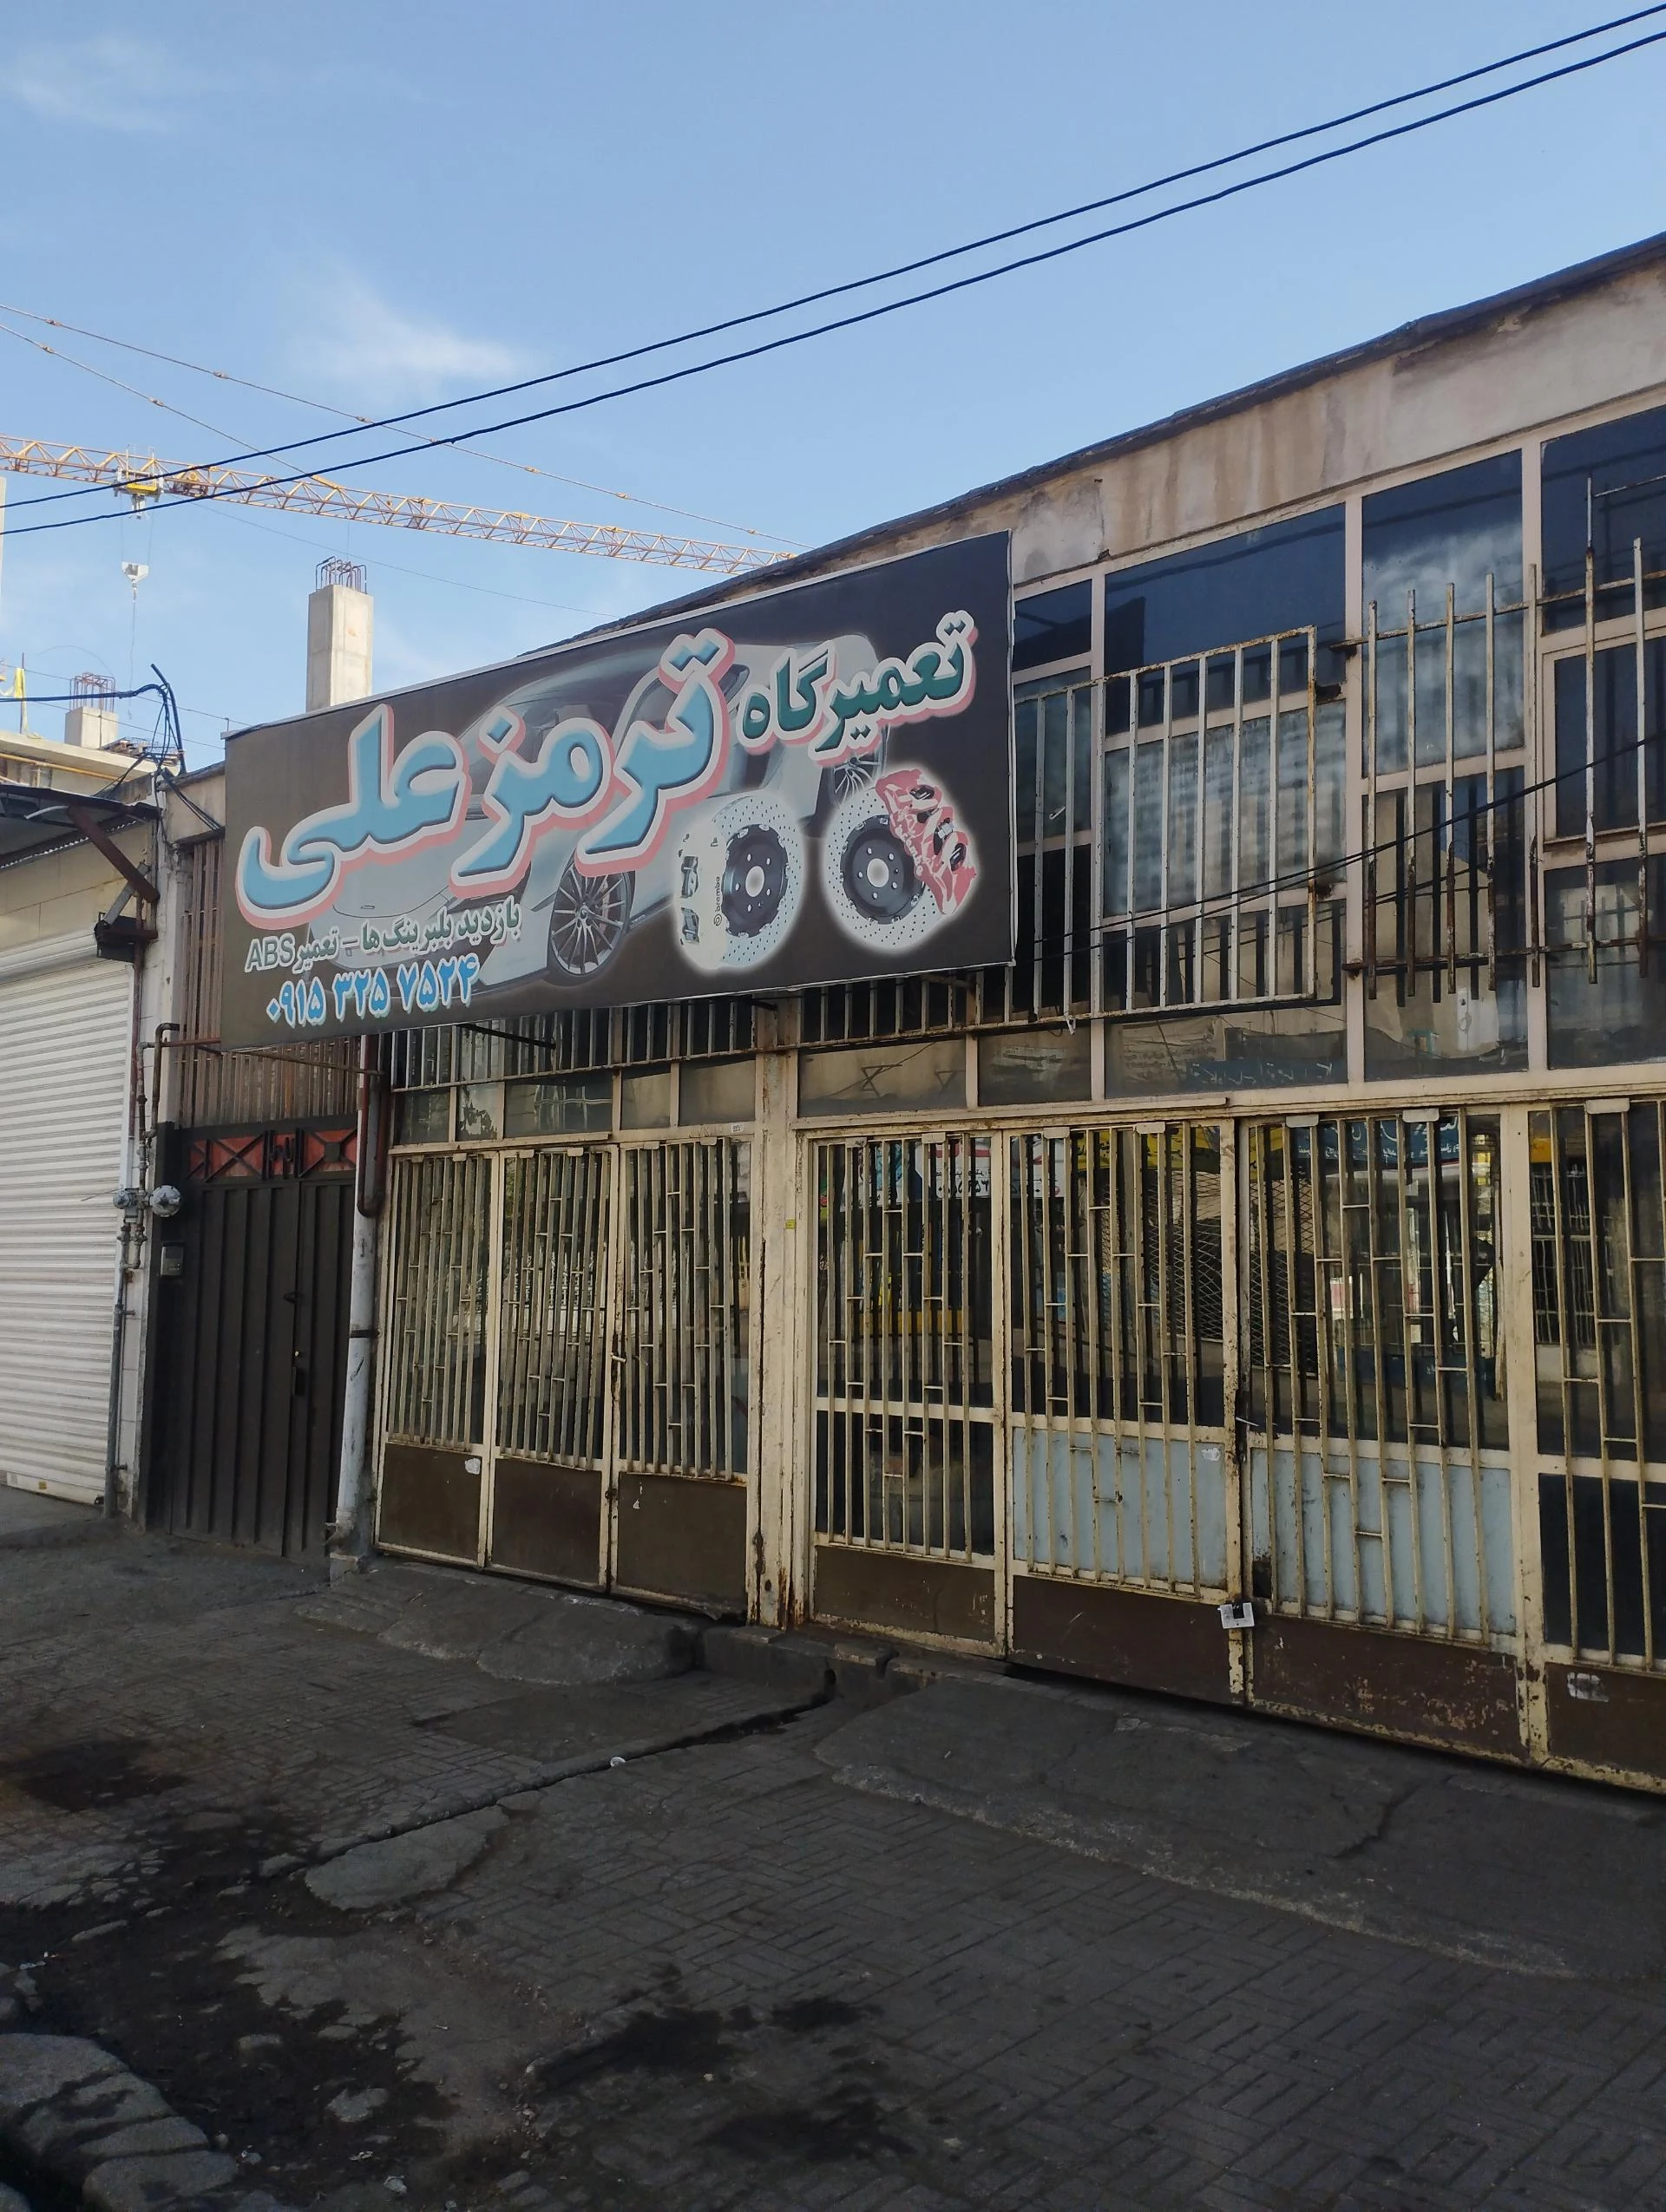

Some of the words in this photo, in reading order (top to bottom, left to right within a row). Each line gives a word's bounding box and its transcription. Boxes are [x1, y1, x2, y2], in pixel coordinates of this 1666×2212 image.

[737, 610, 978, 767] تعمیرگاه
[450, 628, 736, 898] ترمز
[236, 703, 472, 928] علی
[245, 933, 296, 973] ABS
[292, 926, 339, 974] تعمیر
[456, 894, 522, 946] بازدید
[266, 977, 327, 1029] ۰۹۱۵
[332, 967, 392, 1024] ۳۲۵
[397, 952, 480, 1015] ۷۵۲۴
